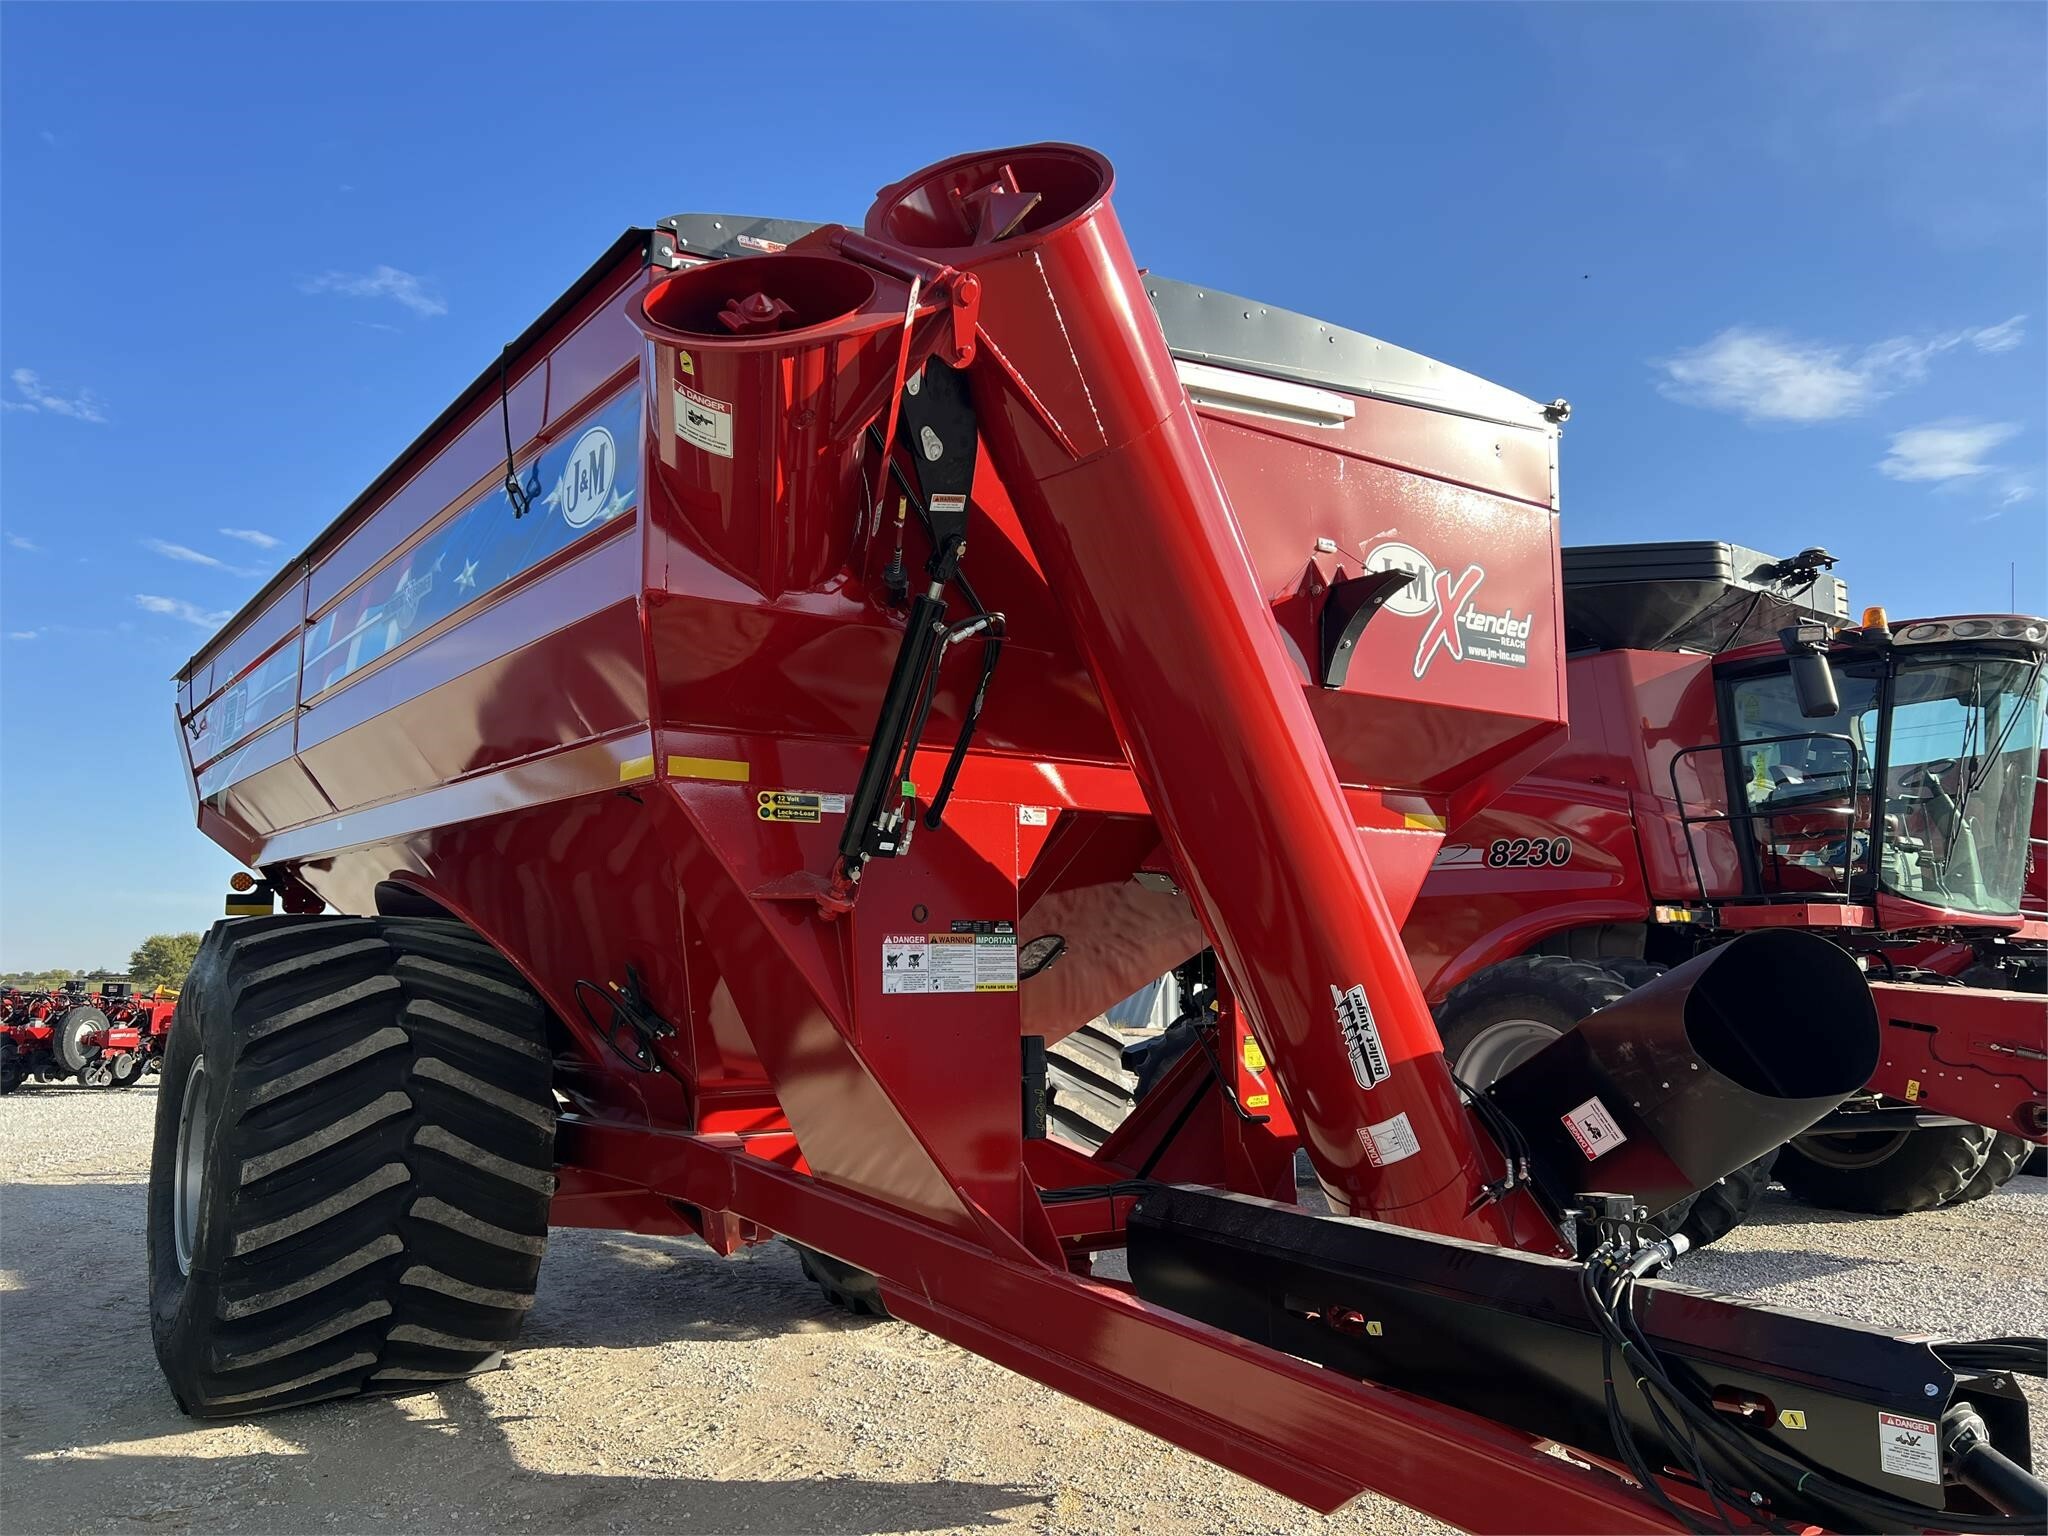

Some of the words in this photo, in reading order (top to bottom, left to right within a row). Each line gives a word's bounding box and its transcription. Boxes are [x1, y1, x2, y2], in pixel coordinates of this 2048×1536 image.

[686, 390, 725, 411] DANGER
[566, 442, 607, 513] J&M
[1468, 646, 1526, 663] www.jm-inc.com
[1500, 638, 1526, 649] REACH
[1488, 836, 1572, 868] 8230
[976, 936, 1016, 944] IMPORTANT
[1353, 992, 1372, 1032] Auger
[1367, 1038, 1385, 1075] Bullet
[1360, 1127, 1379, 1158] DANGER
[1565, 1119, 1588, 1148] DANGER
[1895, 1419, 1930, 1432] DANGER
